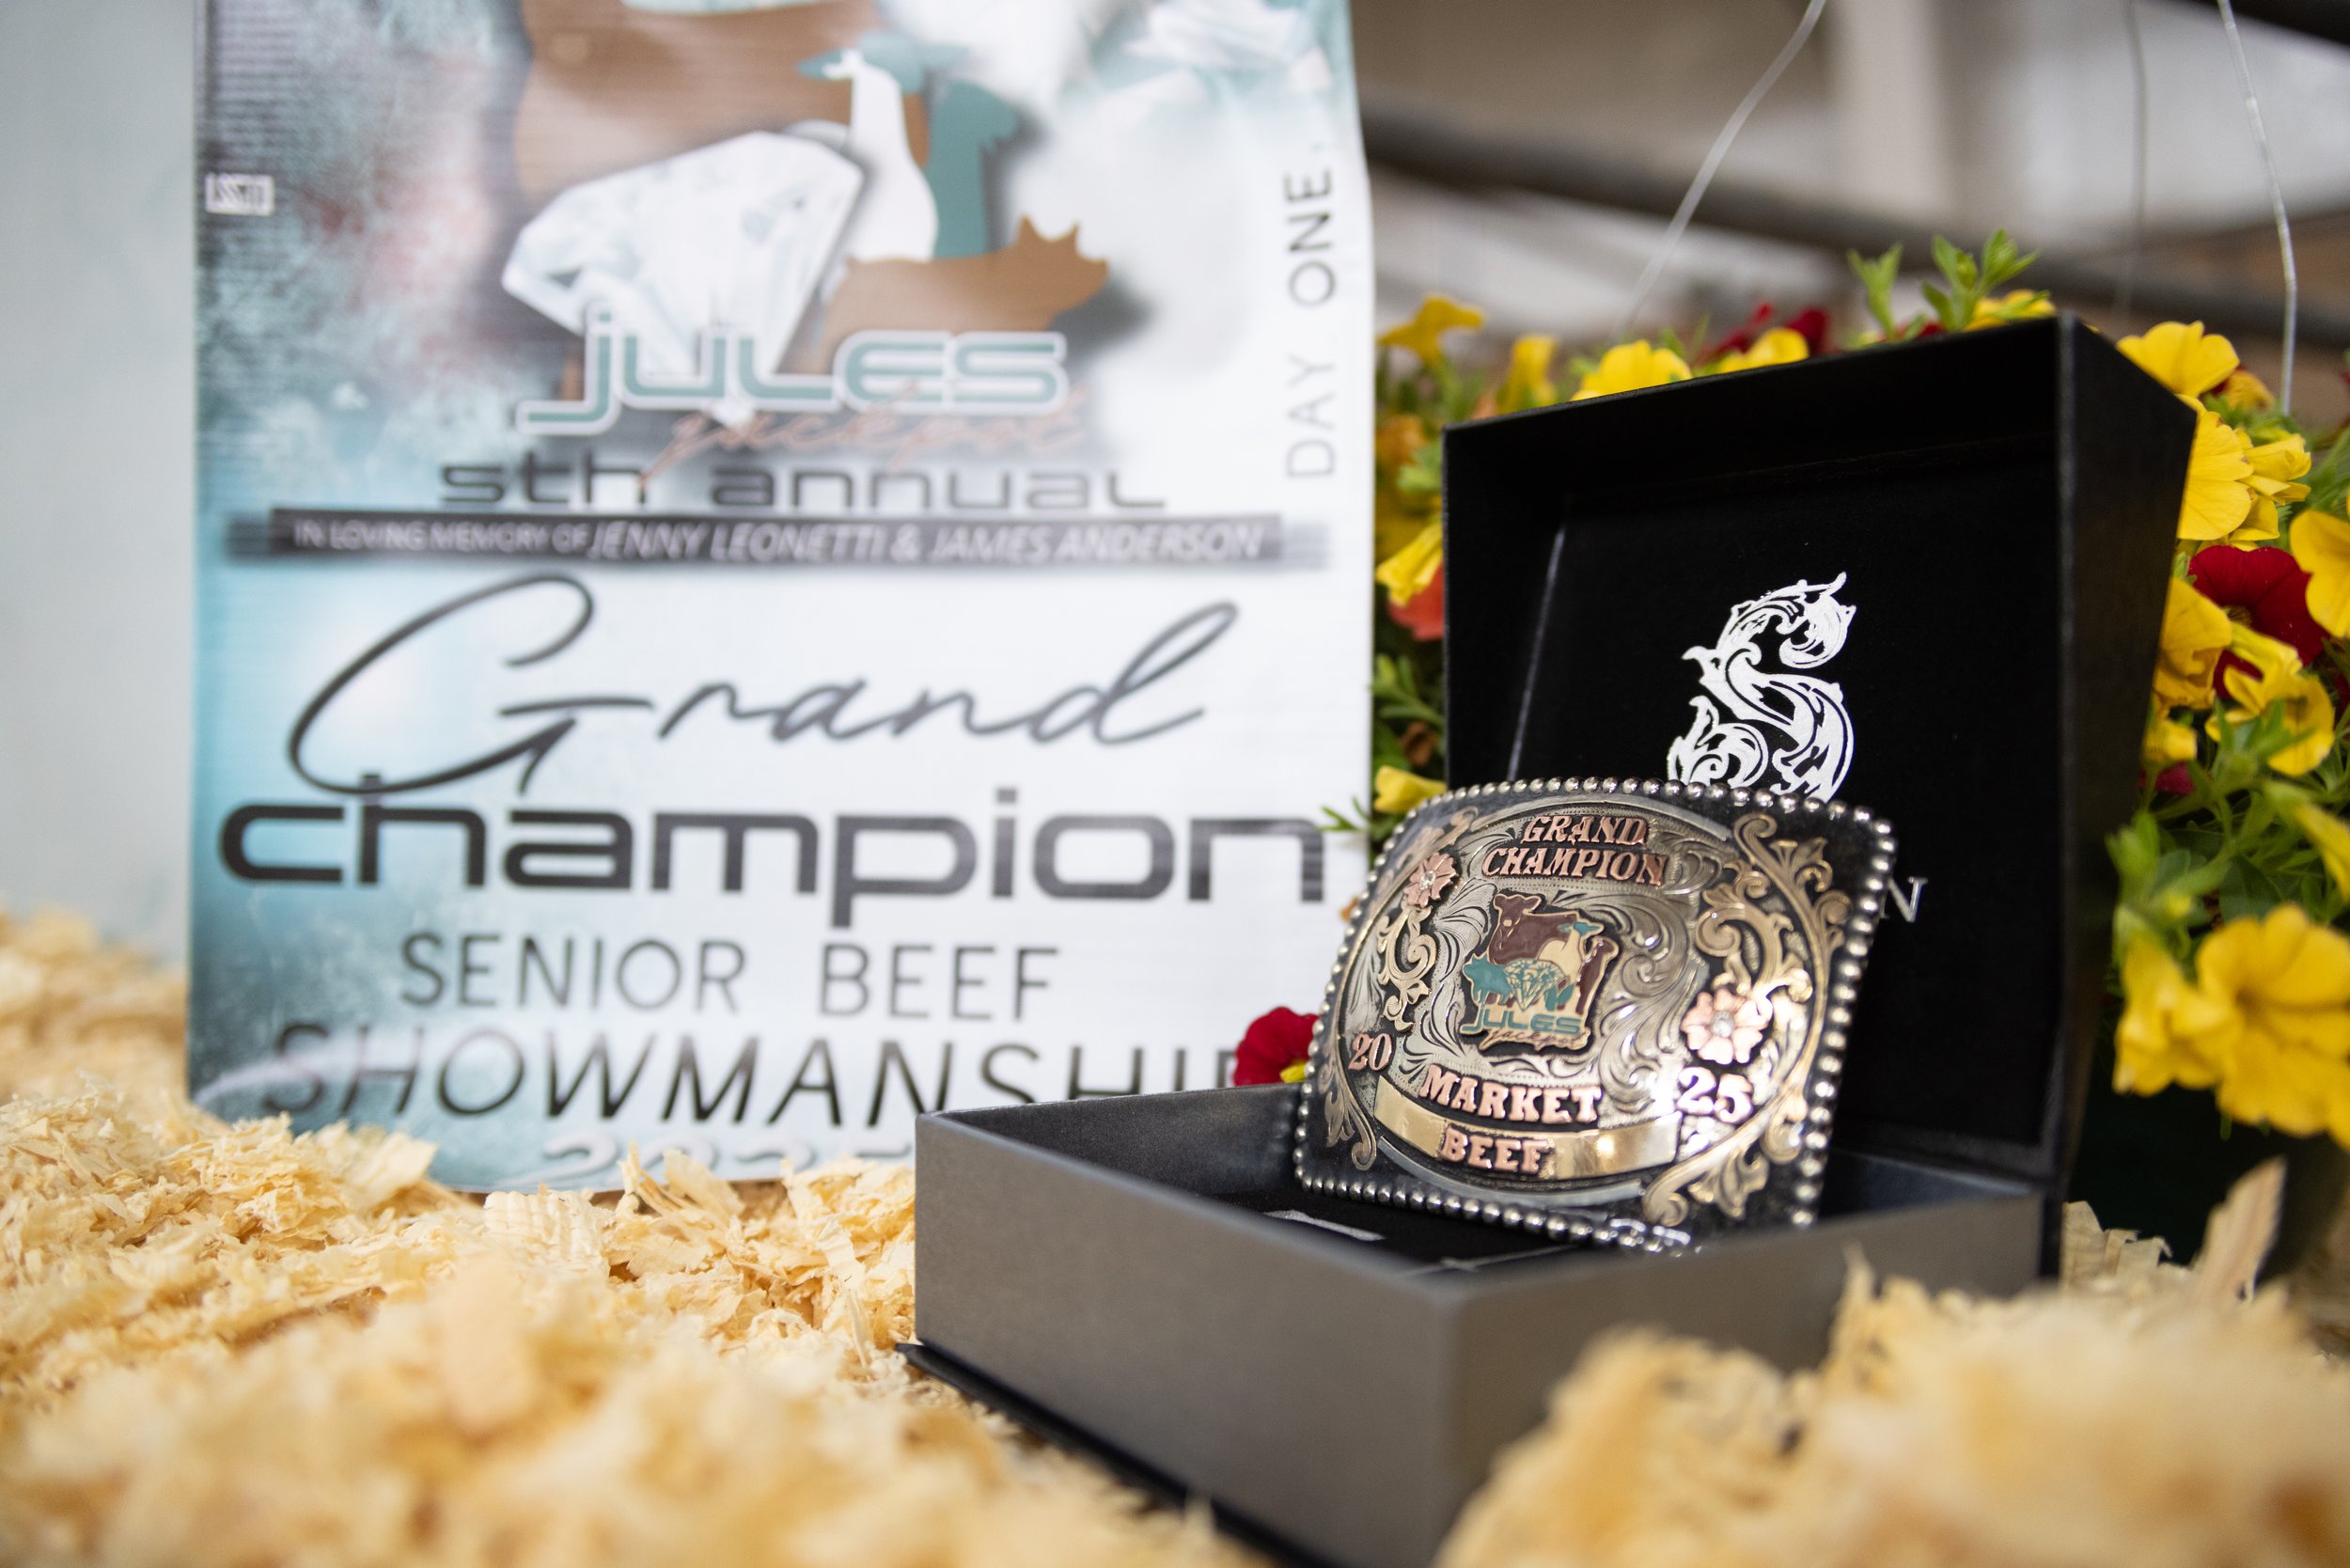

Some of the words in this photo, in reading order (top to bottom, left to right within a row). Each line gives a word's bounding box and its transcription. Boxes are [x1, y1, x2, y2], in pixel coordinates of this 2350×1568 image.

[331, 520, 427, 552] LOVING
[430, 521, 549, 554] MEMORY
[552, 523, 589, 555] OF
[587, 520, 707, 559] JENNY
[710, 522, 890, 562] LEONETTI
[890, 523, 922, 561] &
[931, 525, 1051, 562] JAMES
[1055, 523, 1264, 562] ANDERSON
[288, 572, 1238, 796] Grand
[218, 773, 1325, 930] champion
[1520, 815, 1648, 845] GRAND
[1480, 846, 1668, 886] CHAMPION
[400, 933, 746, 1013] SENIOR
[820, 943, 1059, 1022] BEEF
[263, 1023, 1237, 1128] SHOWMANSH
[1348, 1033, 1393, 1073] 20
[1418, 1065, 1601, 1125] MARKET
[1676, 1066, 1754, 1124] 25
[1441, 1127, 1551, 1173] BEEF
